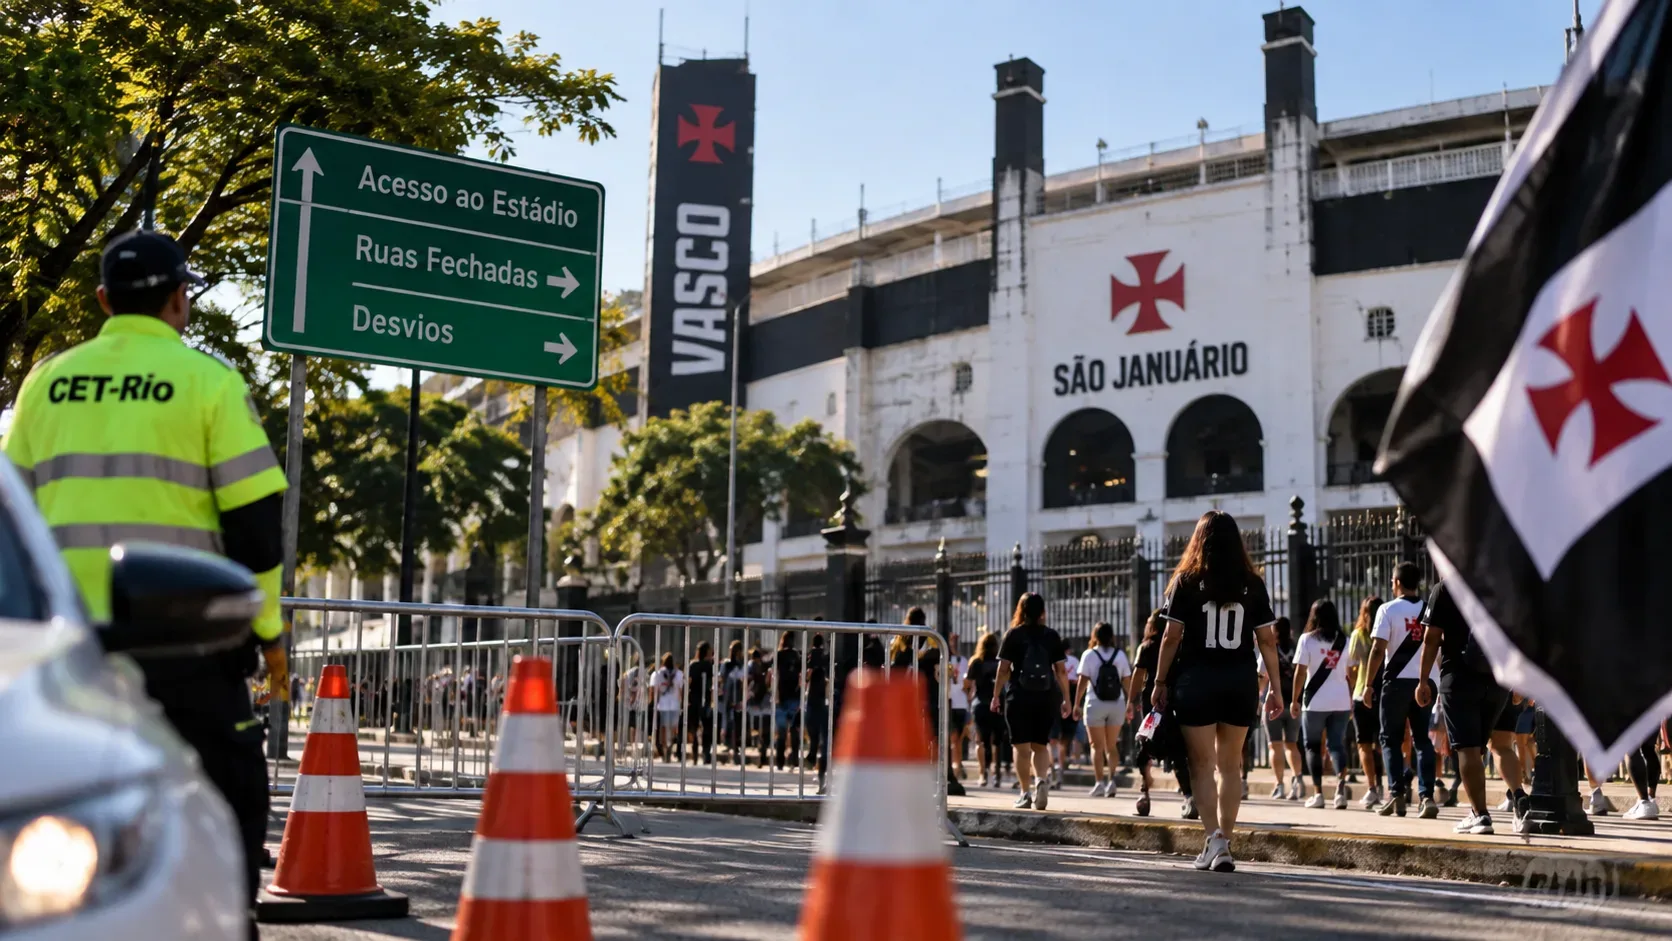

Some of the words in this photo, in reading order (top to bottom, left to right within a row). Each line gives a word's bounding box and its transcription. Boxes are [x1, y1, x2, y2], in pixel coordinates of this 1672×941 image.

[357, 165, 448, 205] Acesso
[456, 190, 484, 211] ao
[493, 189, 578, 229] Estádio
[356, 234, 418, 270] Ruas
[426, 246, 538, 289] Fechadas
[671, 202, 731, 376] VASCO
[352, 304, 454, 345] Desvios
[48, 373, 175, 404] CET-Rio
[1053, 355, 1106, 397] SÃO
[1112, 339, 1249, 390] JANUÁRIO
[1201, 600, 1245, 650] 10
